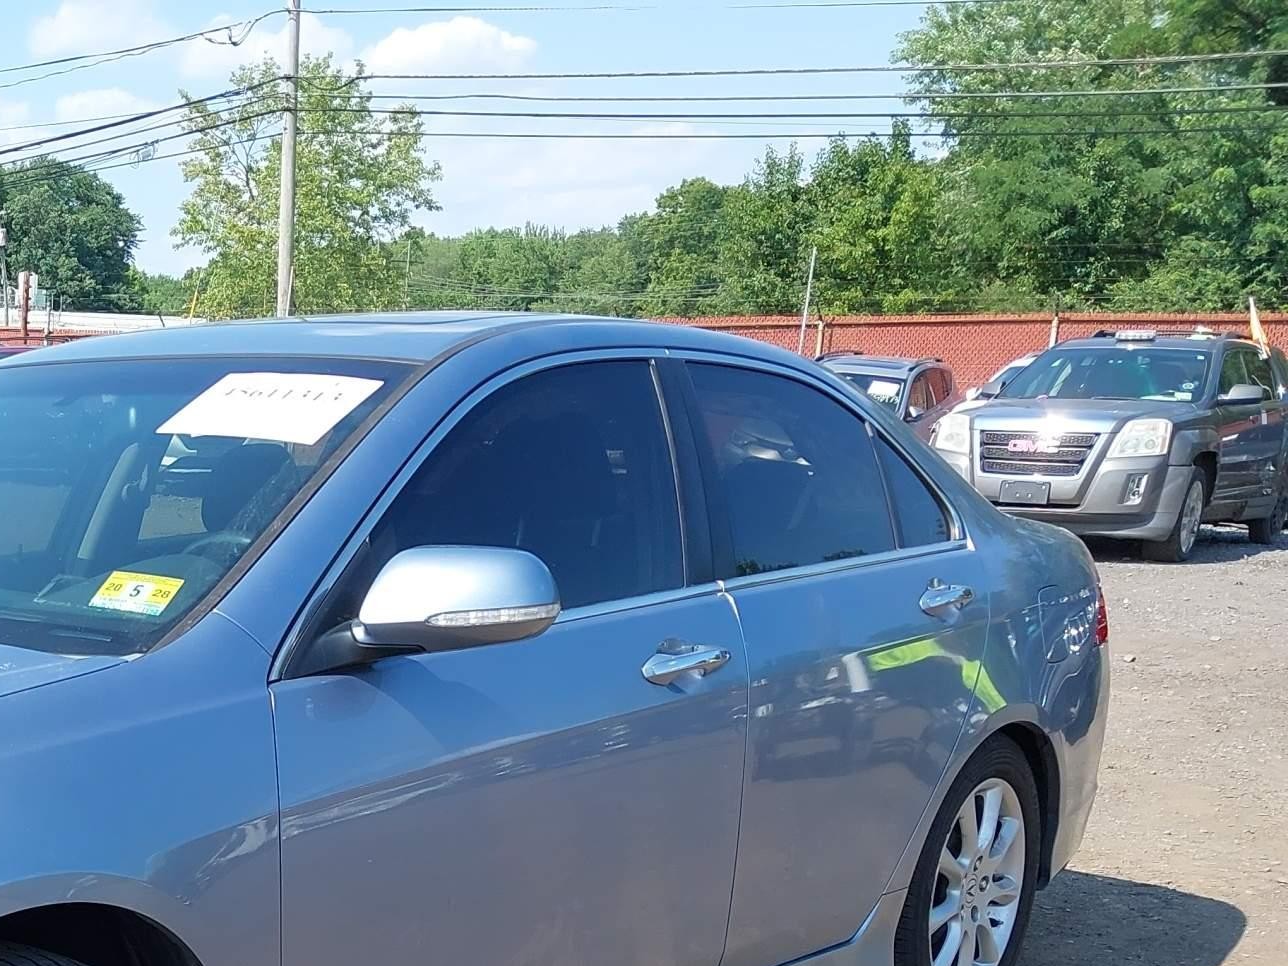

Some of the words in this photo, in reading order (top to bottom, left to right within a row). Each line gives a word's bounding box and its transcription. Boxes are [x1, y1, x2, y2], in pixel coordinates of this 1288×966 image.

[105, 582, 123, 592] 20
[129, 584, 144, 597] 5
[152, 588, 171, 599] 28
